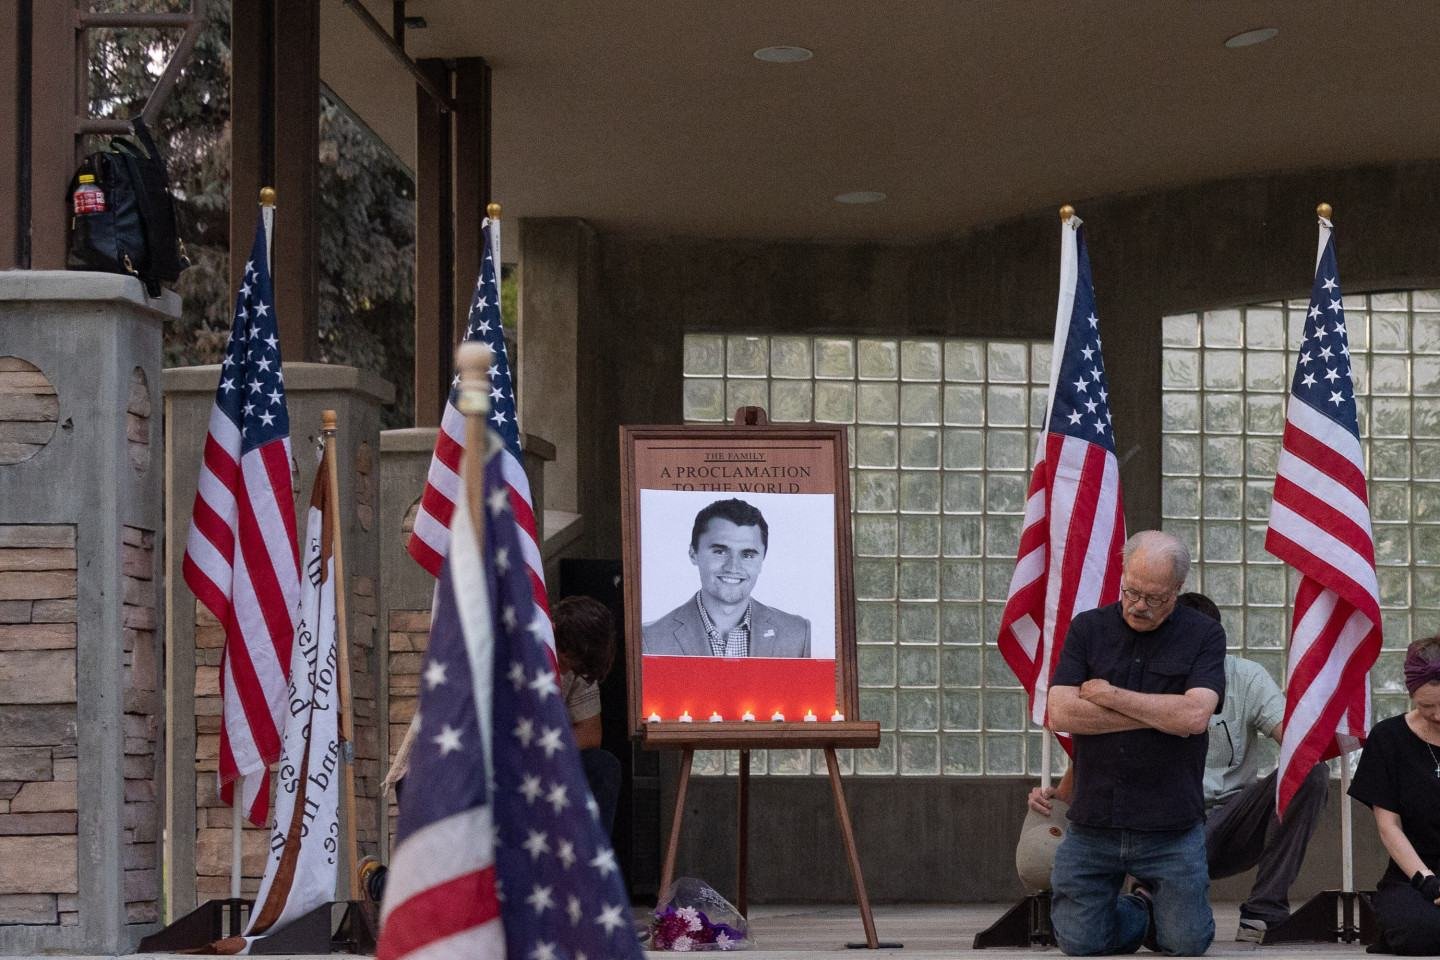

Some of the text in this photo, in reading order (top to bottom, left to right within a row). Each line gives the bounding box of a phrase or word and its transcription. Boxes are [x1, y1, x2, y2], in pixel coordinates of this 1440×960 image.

[705, 452, 766, 460] THE FAMILY
[660, 465, 811, 479] A PROCLAMATION
